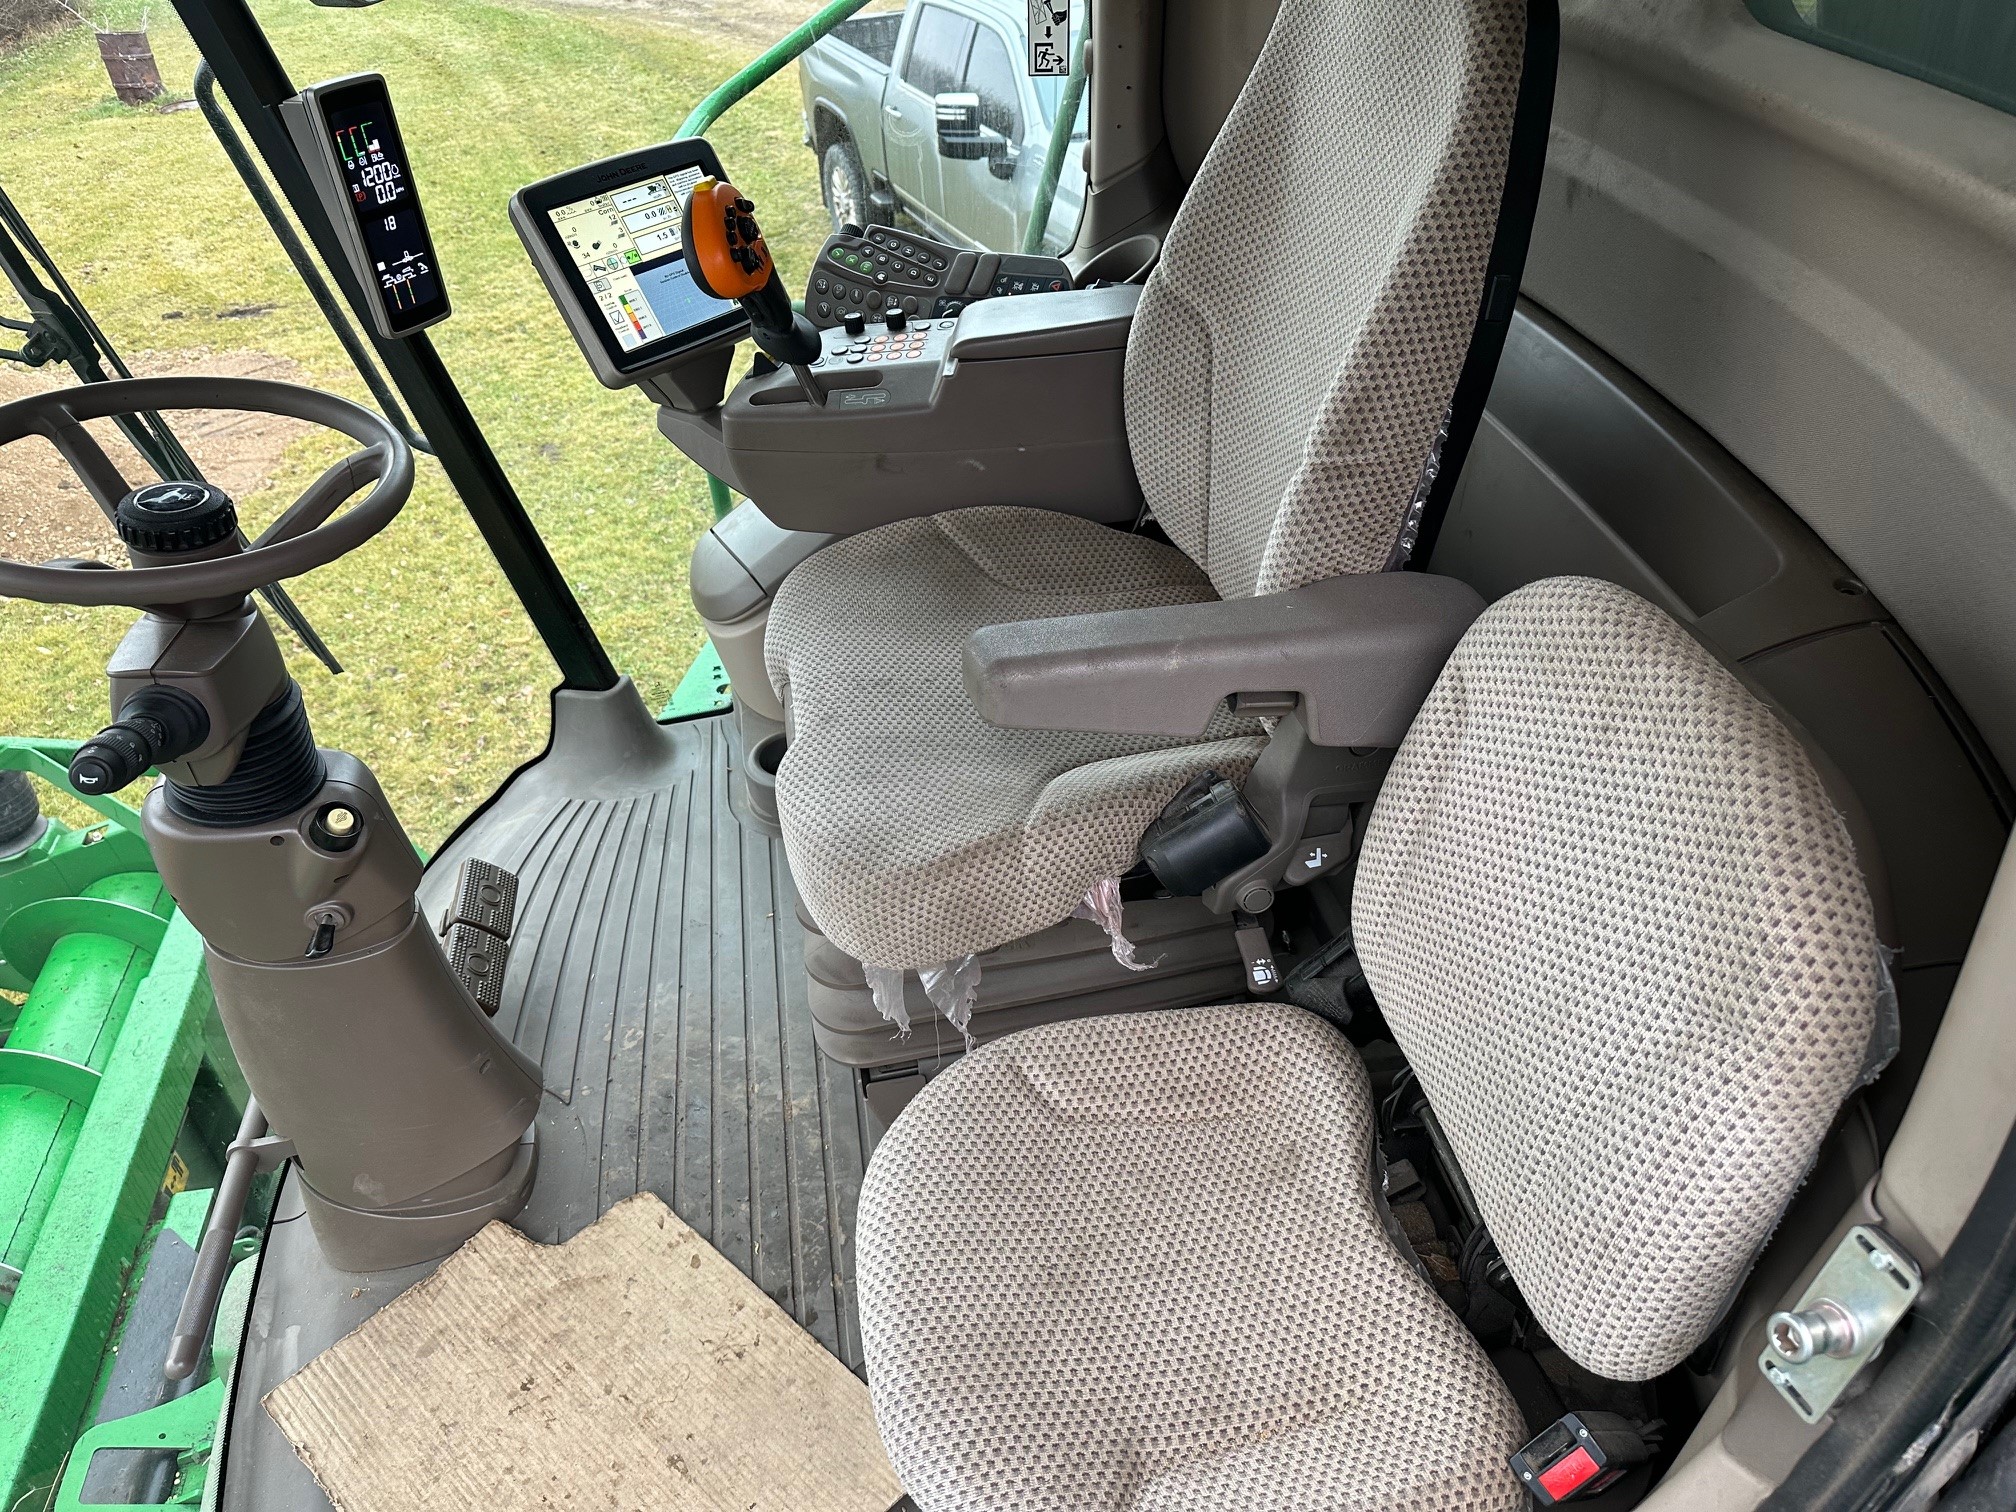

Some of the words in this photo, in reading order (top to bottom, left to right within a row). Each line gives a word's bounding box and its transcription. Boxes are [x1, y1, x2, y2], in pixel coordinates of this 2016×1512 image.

[361, 161, 393, 187] 1200
[597, 172, 618, 183] JOHN
[619, 163, 647, 175] DEERE
[375, 181, 397, 204] 0.0
[598, 206, 614, 216] Corn
[644, 210, 657, 220] 0.0
[384, 215, 397, 231] 18
[656, 231, 669, 241] 1.5
